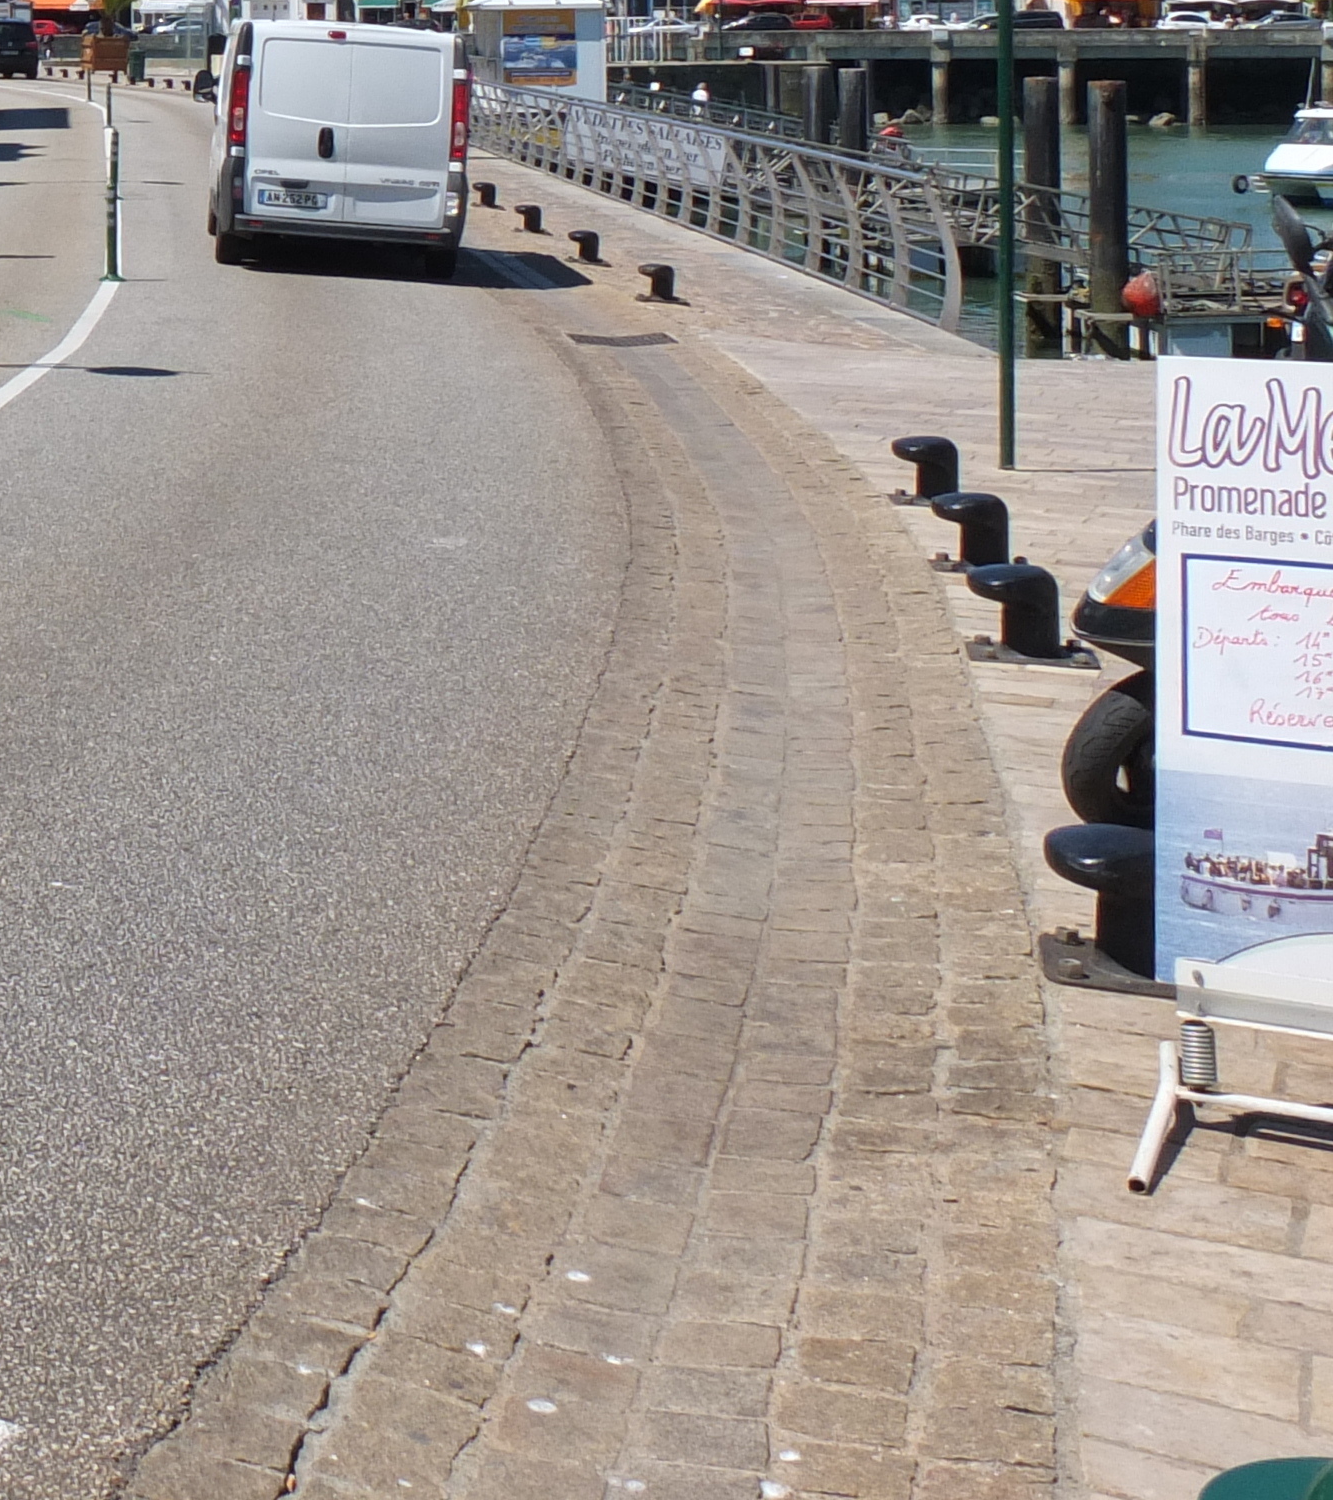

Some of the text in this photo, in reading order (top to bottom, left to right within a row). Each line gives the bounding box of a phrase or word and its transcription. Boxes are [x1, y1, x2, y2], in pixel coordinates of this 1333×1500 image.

[1173, 476, 1327, 519] Promenade
[1172, 521, 1212, 539] Phare
[1216, 524, 1241, 540] des
[1245, 526, 1294, 546] Barges
[1248, 605, 1299, 622] tous
